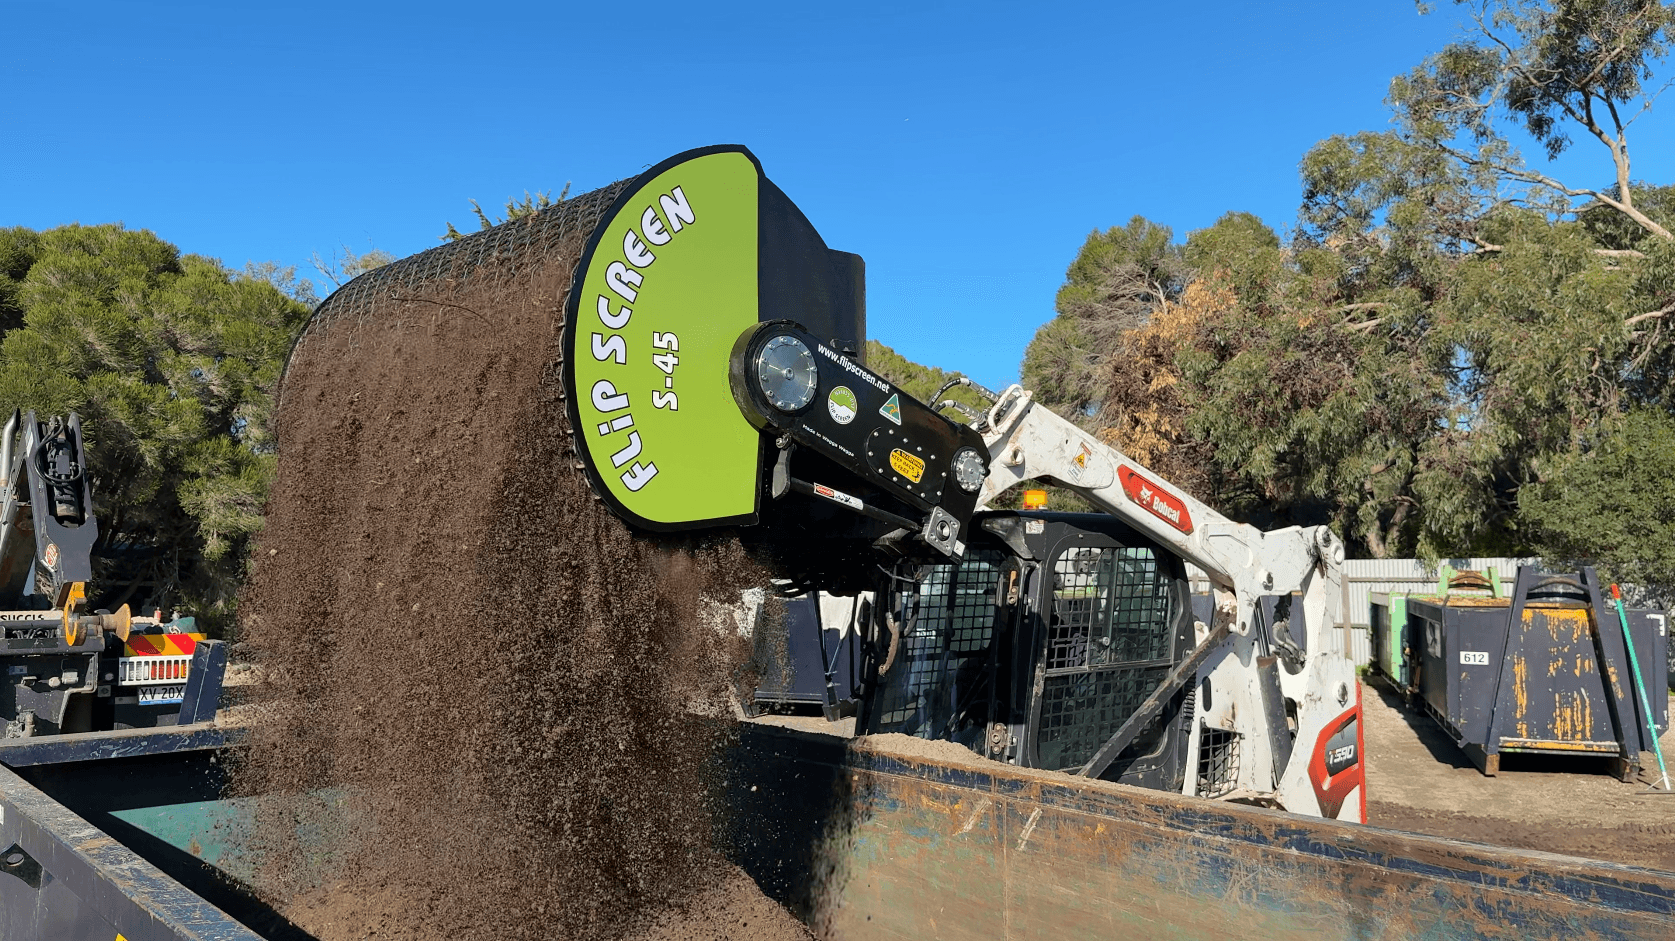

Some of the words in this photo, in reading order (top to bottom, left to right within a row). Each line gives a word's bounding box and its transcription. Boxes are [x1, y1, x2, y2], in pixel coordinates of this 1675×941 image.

[591, 185, 696, 365] SCREEN
[652, 331, 679, 411] S-45
[818, 343, 890, 394] www.flipscreen.net
[1152, 496, 1180, 524] Bobcat
[1464, 653, 1485, 663] 612
